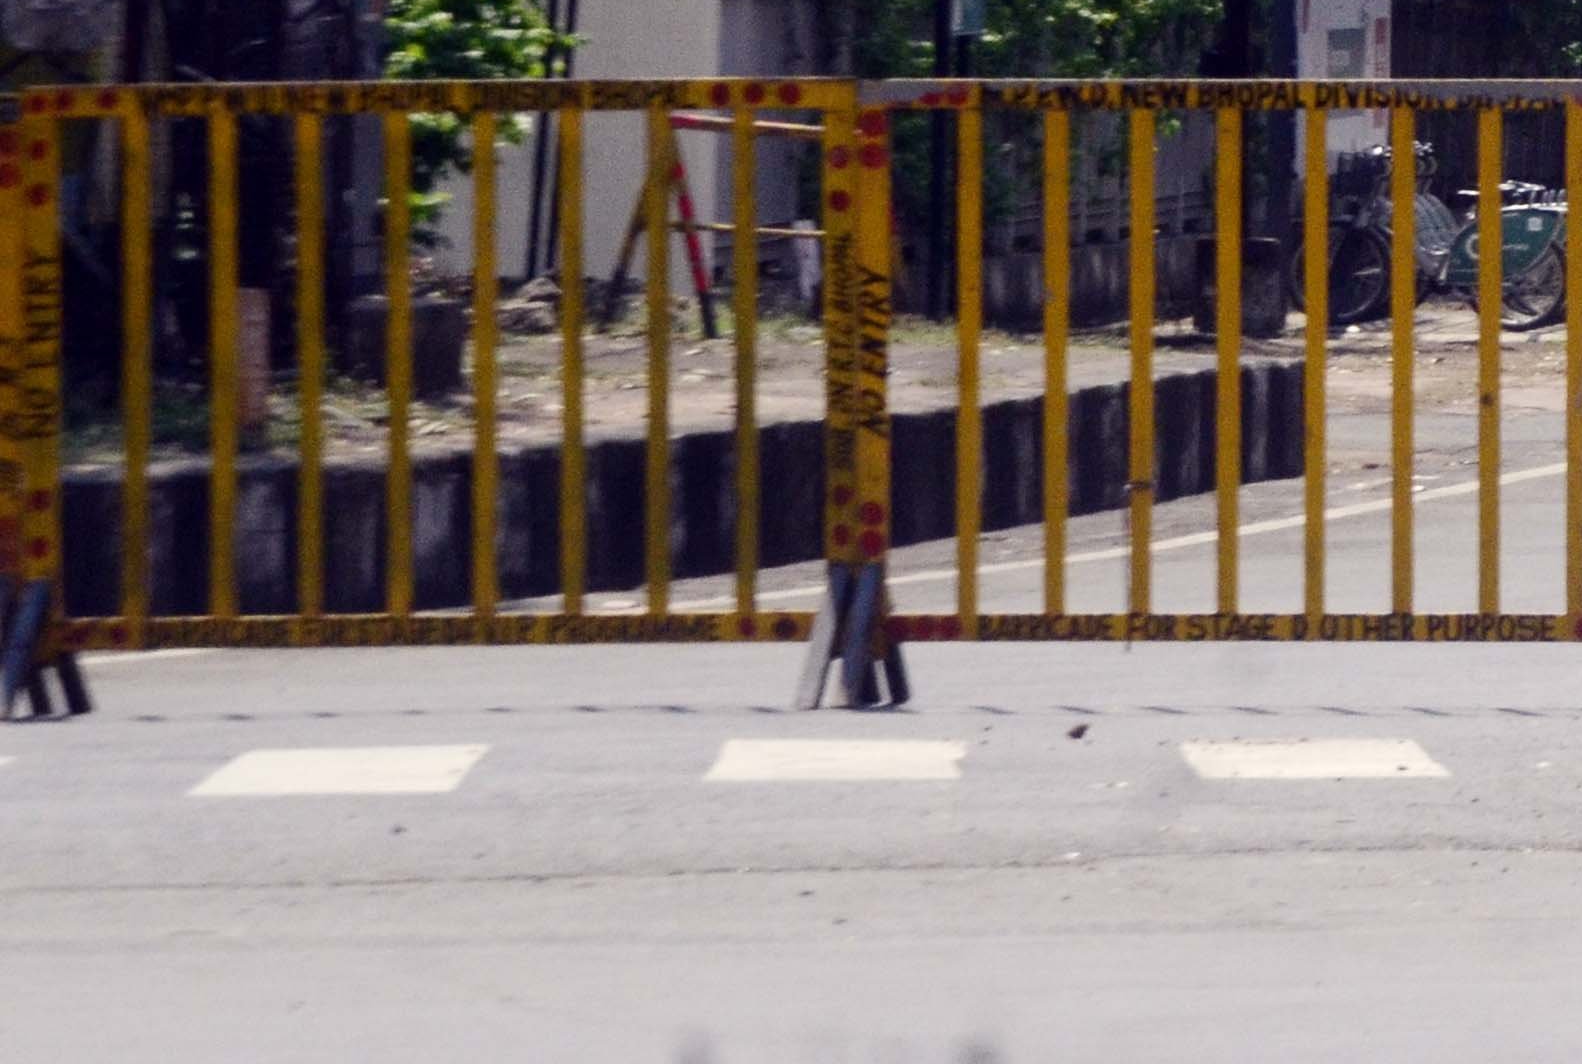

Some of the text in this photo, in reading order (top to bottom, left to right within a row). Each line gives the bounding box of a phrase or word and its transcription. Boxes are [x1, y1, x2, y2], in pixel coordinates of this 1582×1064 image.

[1315, 82, 1436, 109] DIVISIO
[856, 262, 888, 438] NO ENTRY
[978, 615, 1113, 641] BARRICADE
[1129, 615, 1176, 641] FOR
[1185, 615, 1276, 641] STAGE
[1318, 615, 1416, 641] OTHER
[1427, 615, 1556, 641] PURPOSE
